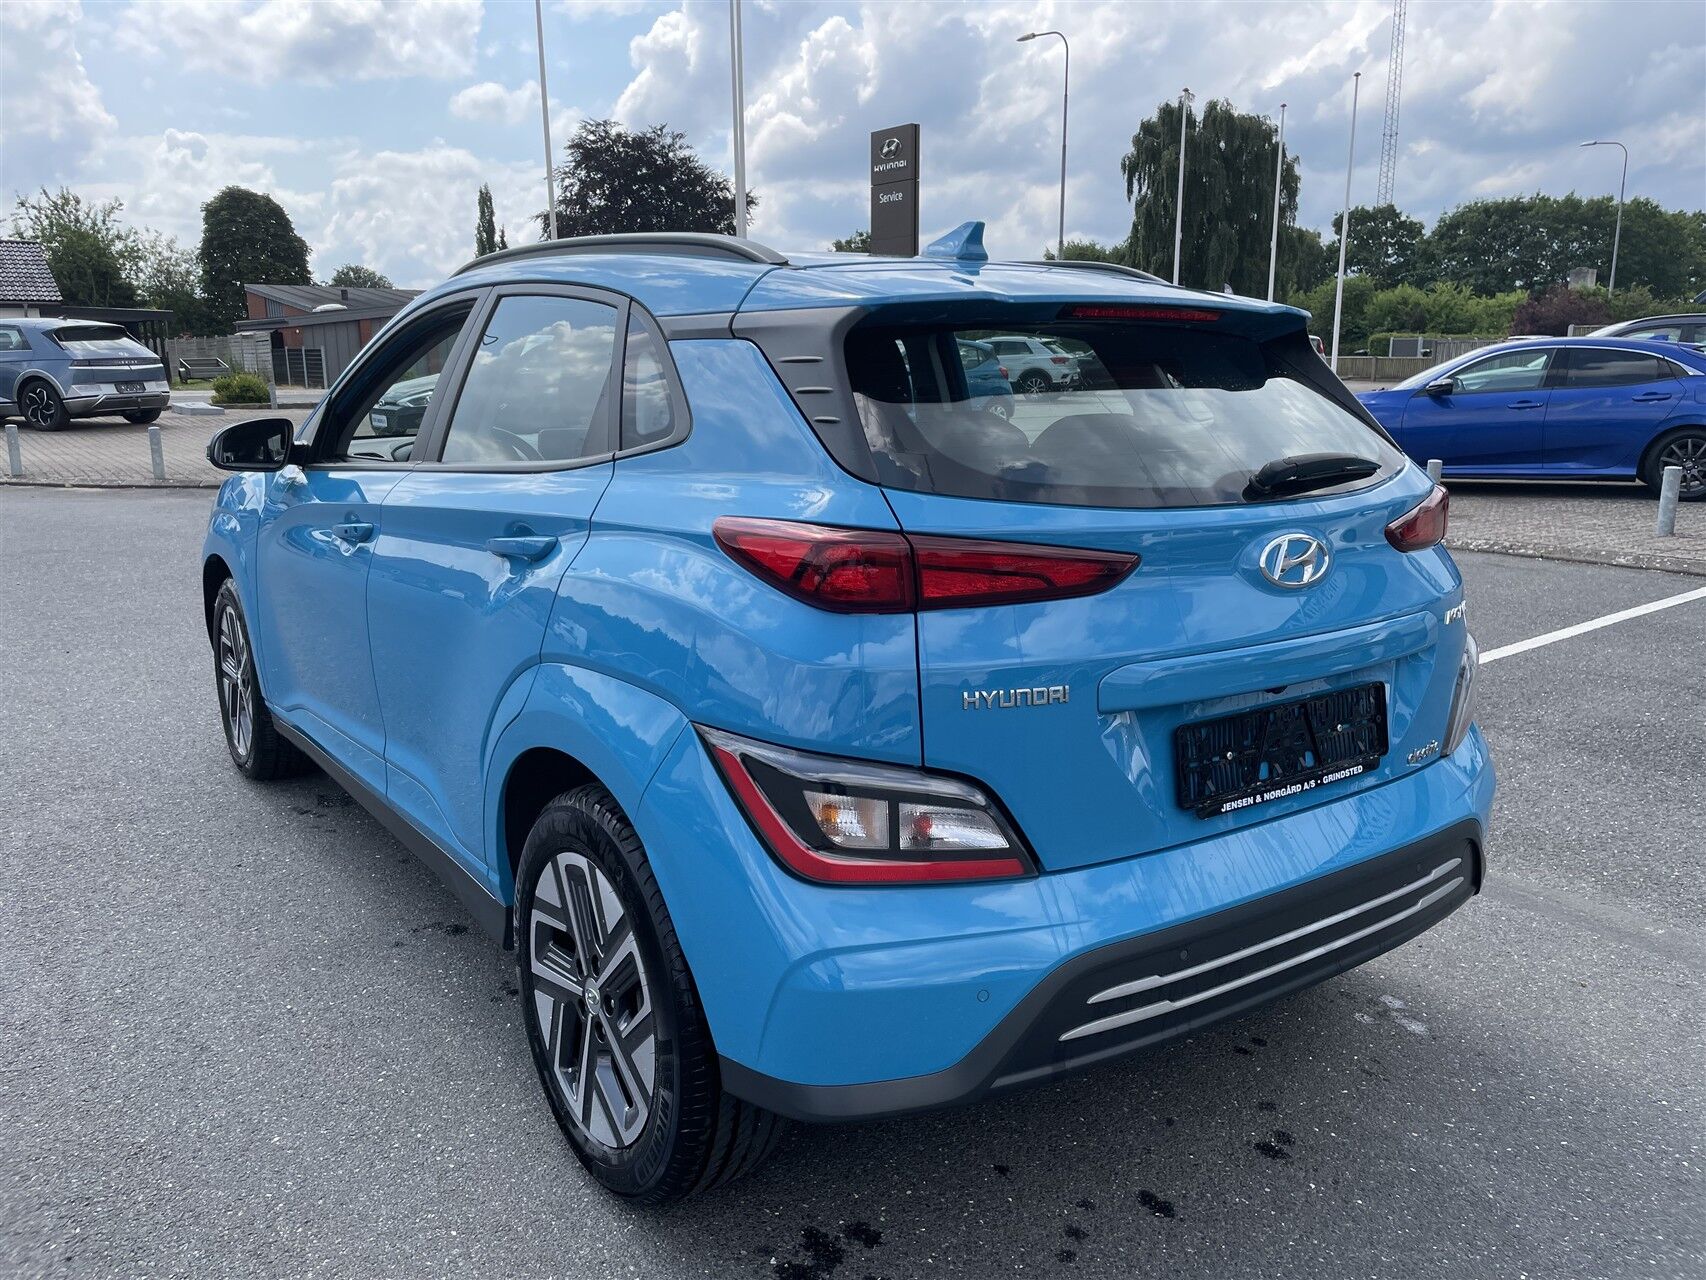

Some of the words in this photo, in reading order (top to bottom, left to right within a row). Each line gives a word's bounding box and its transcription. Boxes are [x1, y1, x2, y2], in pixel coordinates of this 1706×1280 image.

[879, 191, 903, 204] Service
[962, 685, 1070, 710] HYUNDAI
[1221, 796, 1254, 812] JENSEN
[1255, 794, 1262, 803] &
[1263, 783, 1302, 801] NØRGÅRD
[1303, 780, 1316, 791] A/S
[1322, 765, 1363, 784] GRINDSTED
